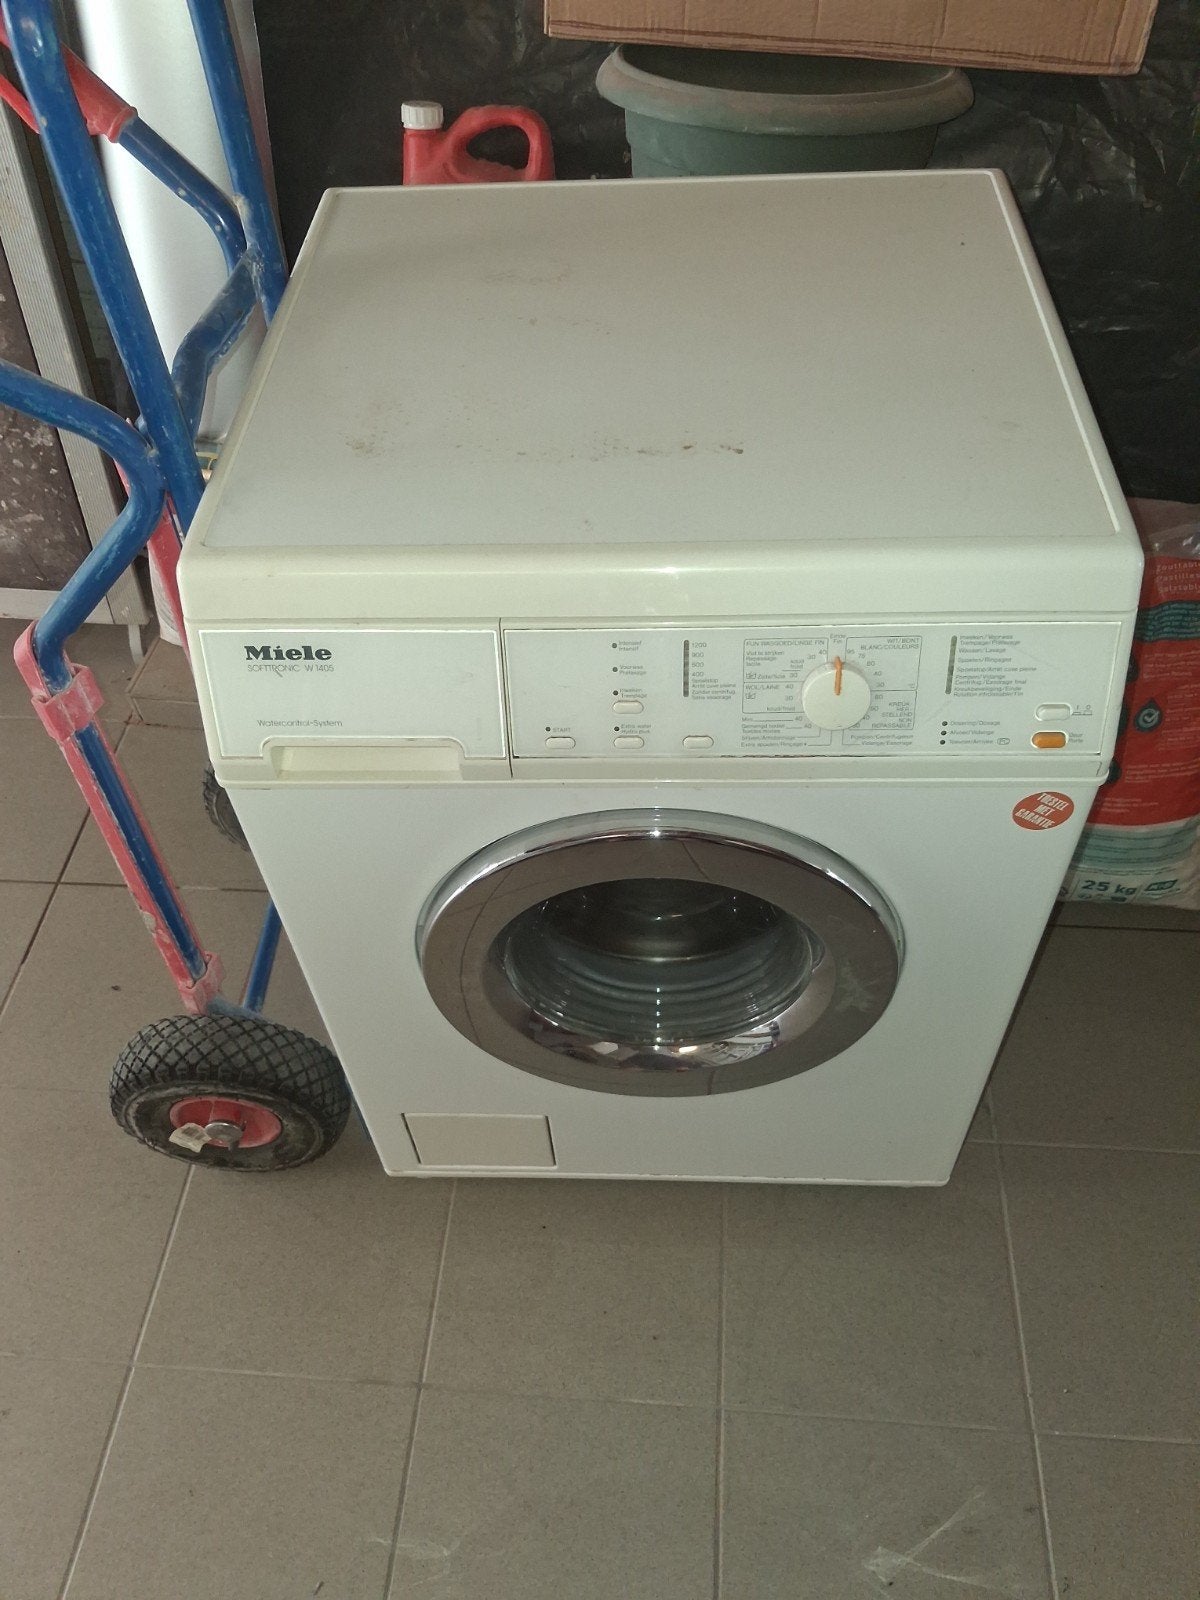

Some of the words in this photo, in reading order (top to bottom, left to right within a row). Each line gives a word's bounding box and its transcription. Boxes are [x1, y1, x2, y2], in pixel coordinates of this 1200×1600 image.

[243, 645, 332, 661] Miele
[247, 664, 300, 672] SOFTTRONIC
[304, 664, 314, 672] W
[315, 664, 335, 672] 1405
[256, 719, 343, 727] Watercontrol-System
[1081, 879, 1110, 892] 25
[1115, 883, 1138, 896] kg
